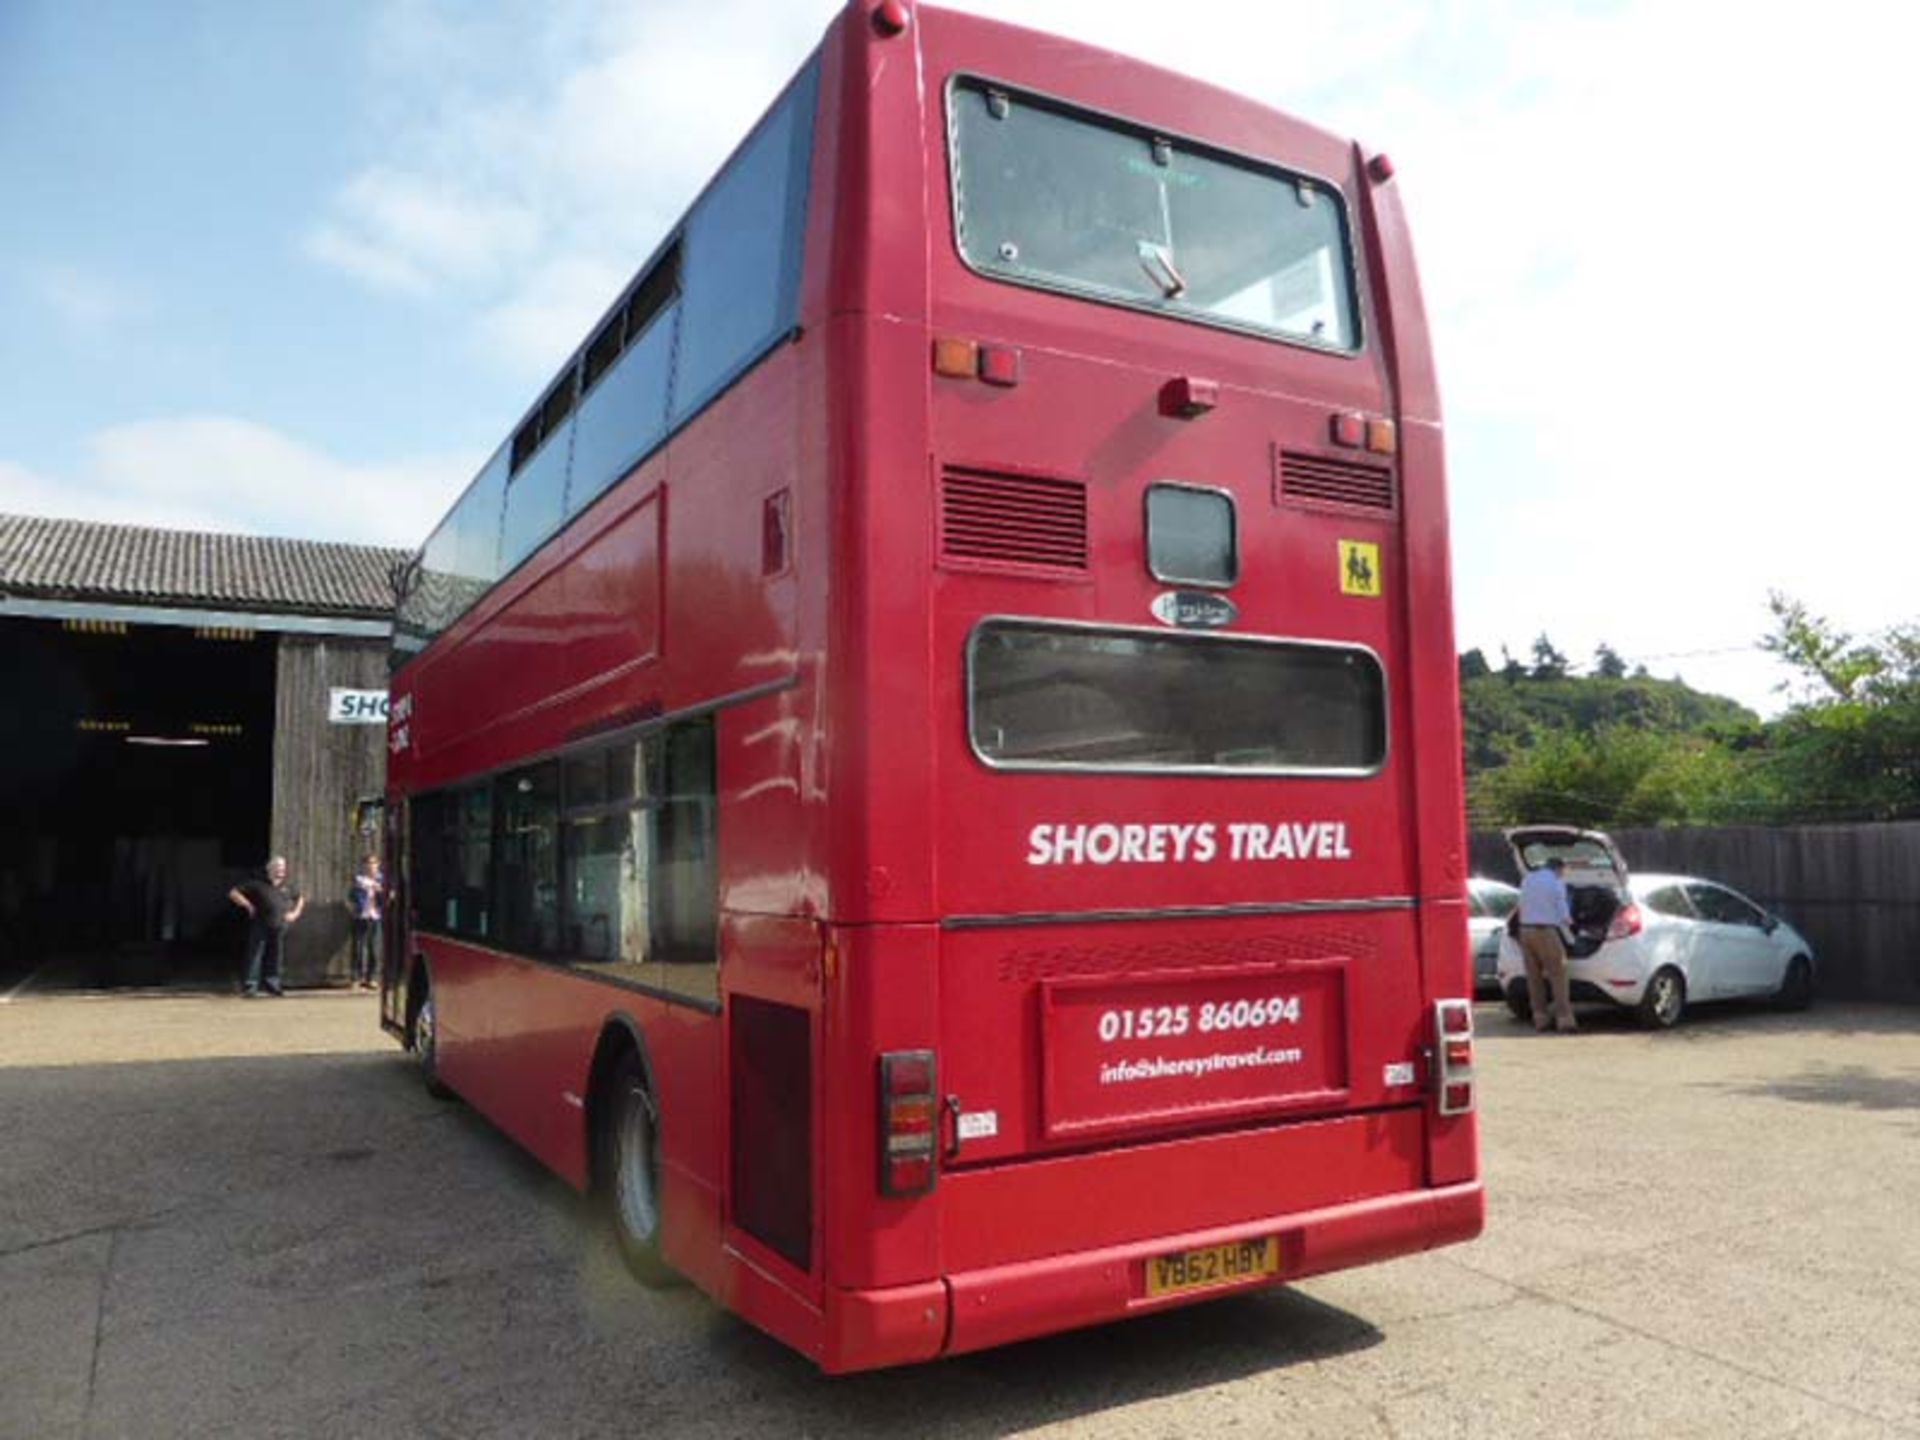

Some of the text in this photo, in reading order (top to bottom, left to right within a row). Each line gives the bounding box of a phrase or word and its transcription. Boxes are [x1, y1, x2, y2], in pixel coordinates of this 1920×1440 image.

[1027, 822, 1351, 865] SHOREYS TRAVEL
[1099, 997, 1301, 1041] 01525 860694
[1100, 1047, 1302, 1084] info@shoreystravel.com
